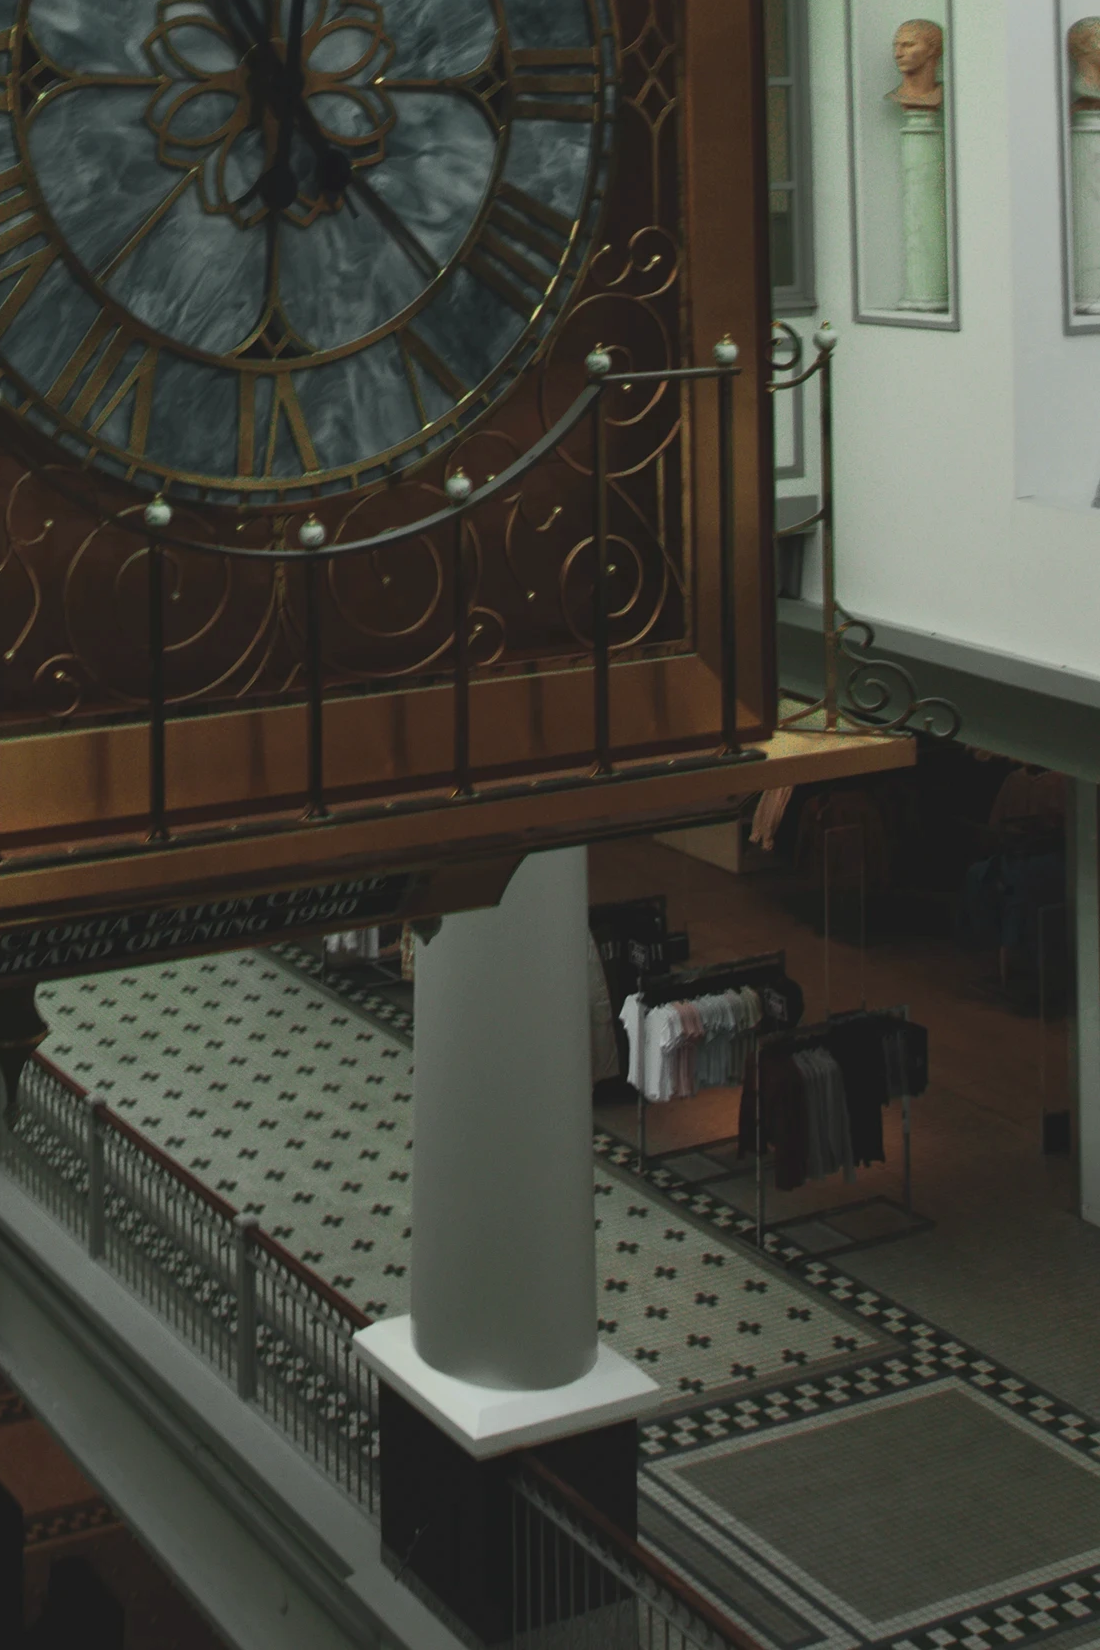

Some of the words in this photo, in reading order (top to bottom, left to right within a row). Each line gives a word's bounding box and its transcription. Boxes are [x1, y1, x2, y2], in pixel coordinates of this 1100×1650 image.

[510, 46, 600, 122] III
[462, 180, 580, 322] IIII
[395, 323, 467, 425] V
[237, 365, 320, 477] VI
[126, 917, 267, 952] OPENING
[284, 897, 357, 925] 1990
[146, 897, 254, 930] EATON
[266, 874, 387, 908] CENTRE
